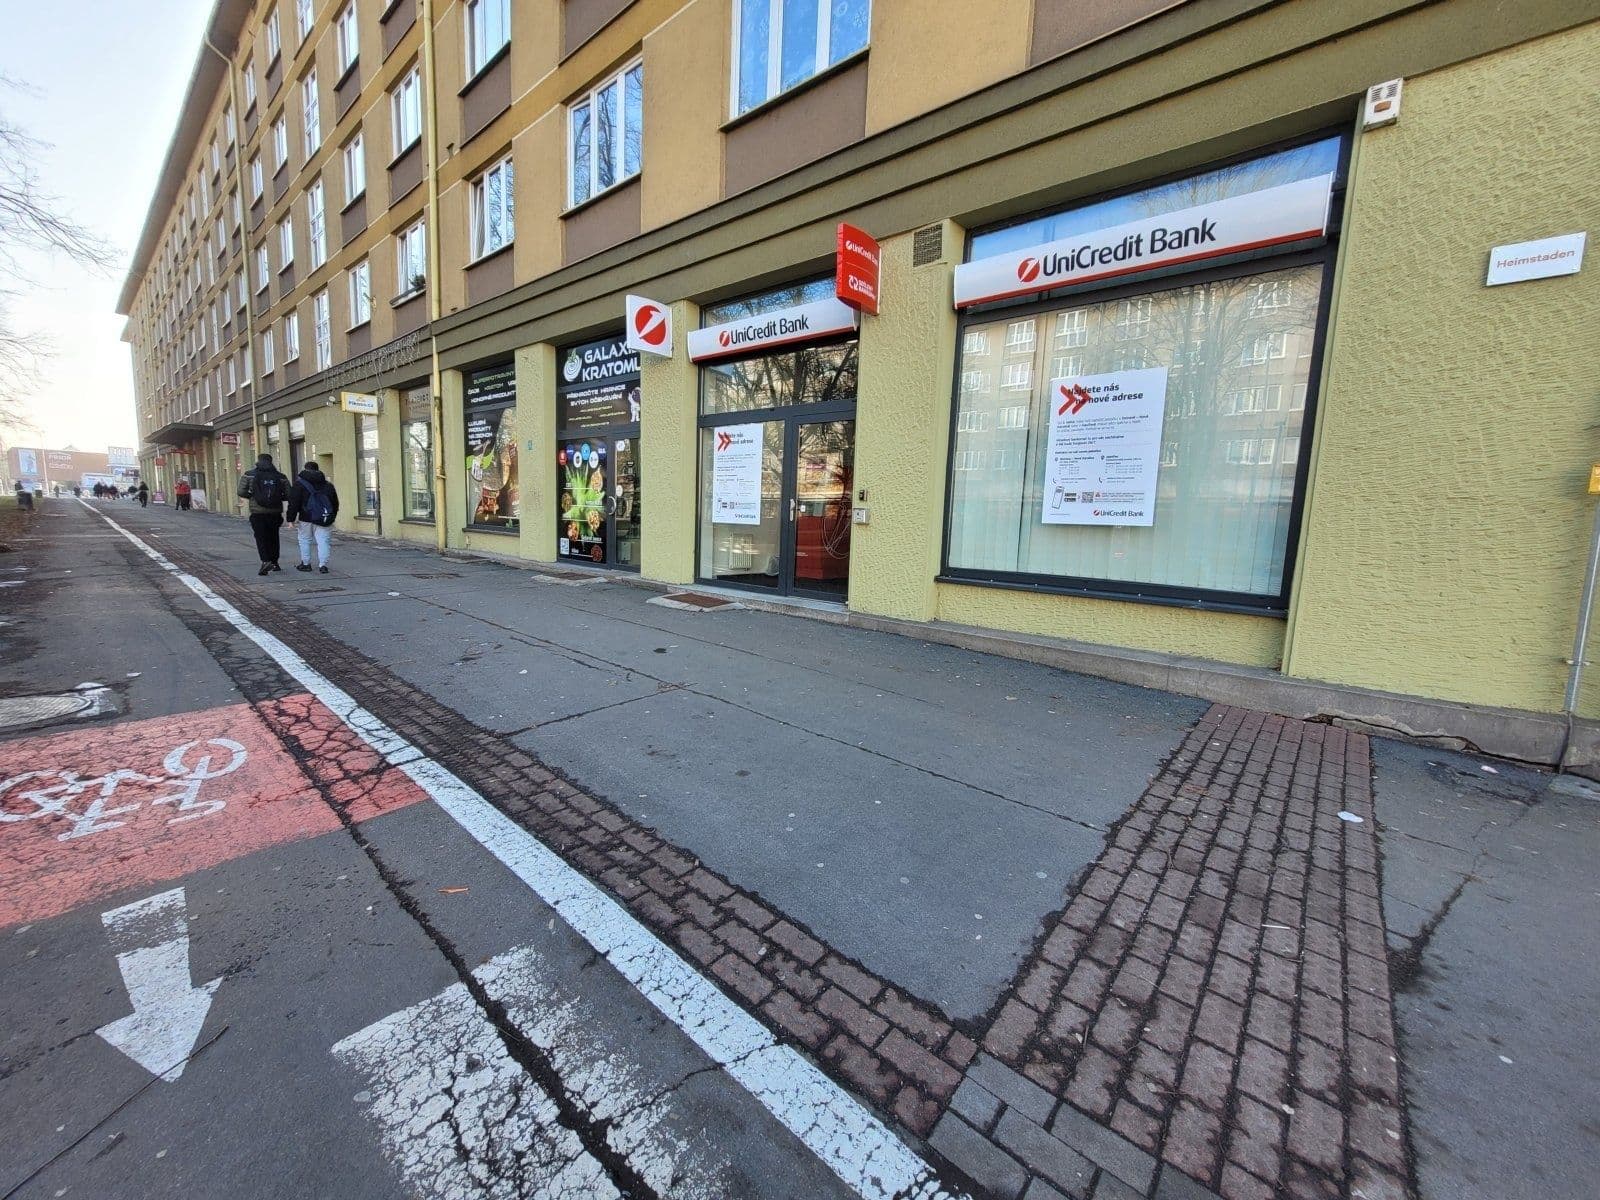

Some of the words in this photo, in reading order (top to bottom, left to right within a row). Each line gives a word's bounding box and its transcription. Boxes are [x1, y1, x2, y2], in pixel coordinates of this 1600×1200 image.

[1043, 232, 1143, 277] UniCredit
[1150, 217, 1217, 255] Bank
[1496, 249, 1576, 270] Heimstaden
[730, 321, 778, 345] UniCredit
[779, 314, 809, 334] Bank
[584, 341, 637, 364] GALAX
[1088, 393, 1110, 404] nové
[1111, 392, 1144, 402] adrese
[1103, 382, 1120, 393] nás
[1100, 509, 1128, 518] UniCredit
[1128, 509, 1145, 518] Bank
